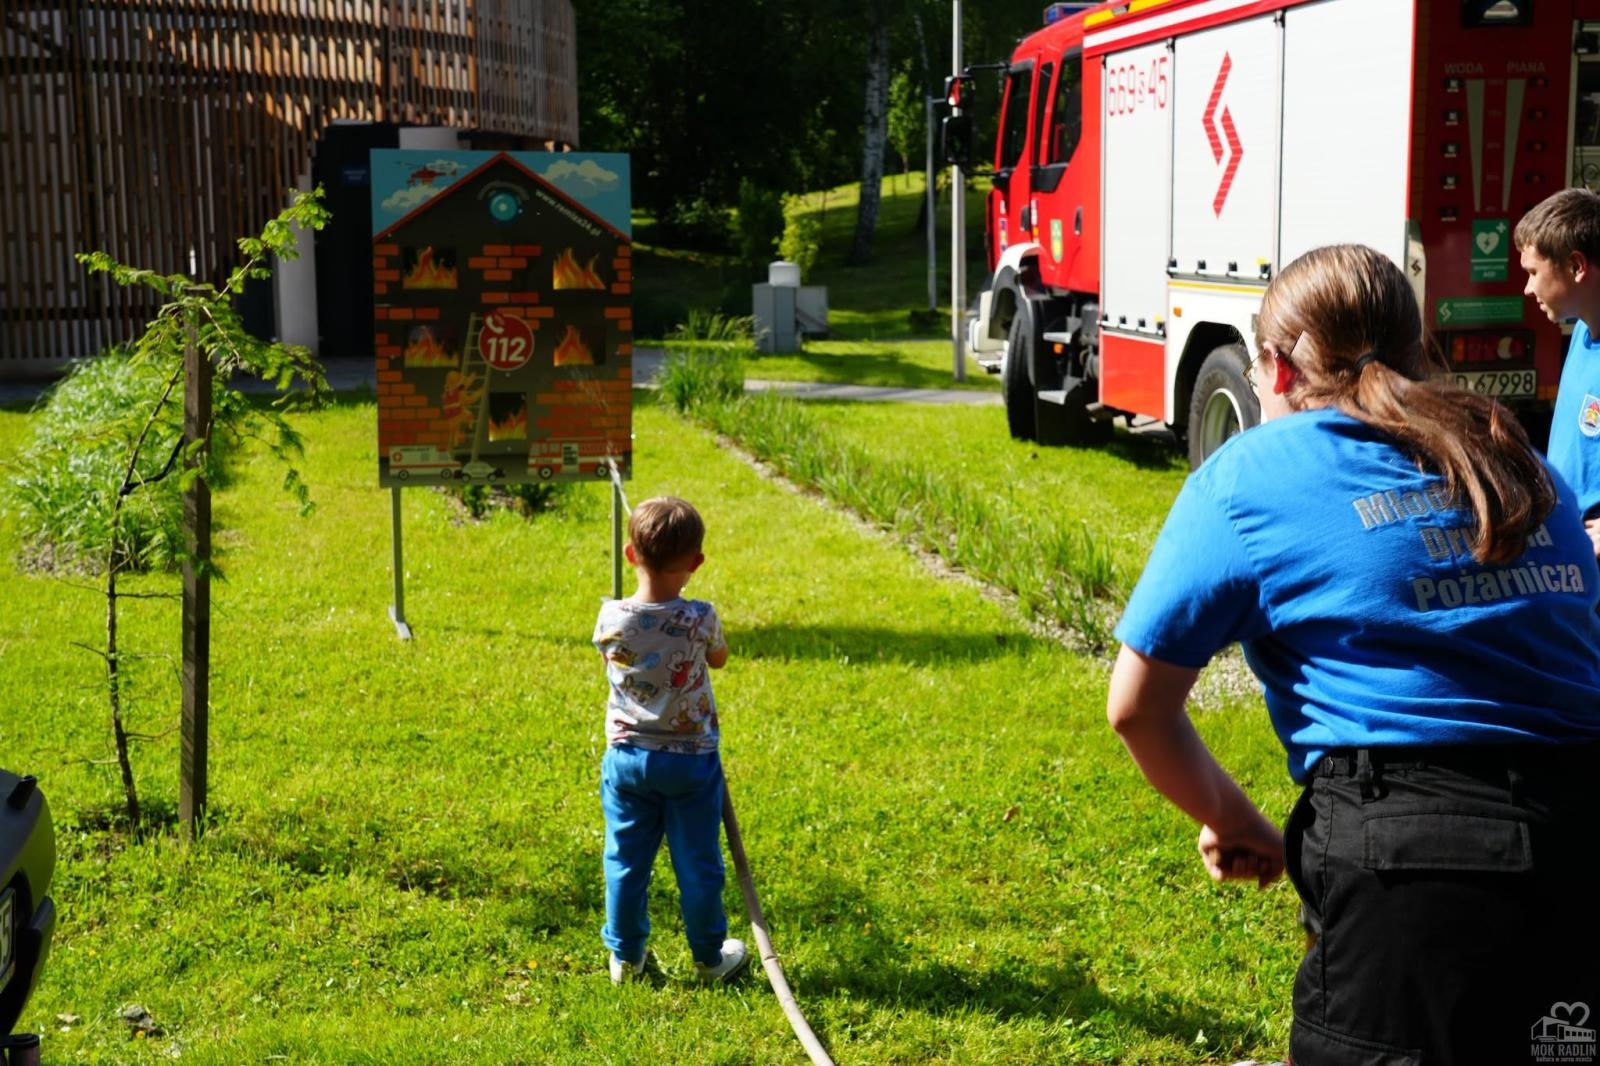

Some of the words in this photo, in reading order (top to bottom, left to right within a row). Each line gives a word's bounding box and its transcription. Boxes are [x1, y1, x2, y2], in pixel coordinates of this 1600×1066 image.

[1444, 62, 1484, 74] WODA
[1507, 61, 1546, 74] PIANA
[487, 336, 526, 363] 112
[1474, 372, 1533, 394] 67998
[1412, 560, 1584, 612] Pożarnicza
